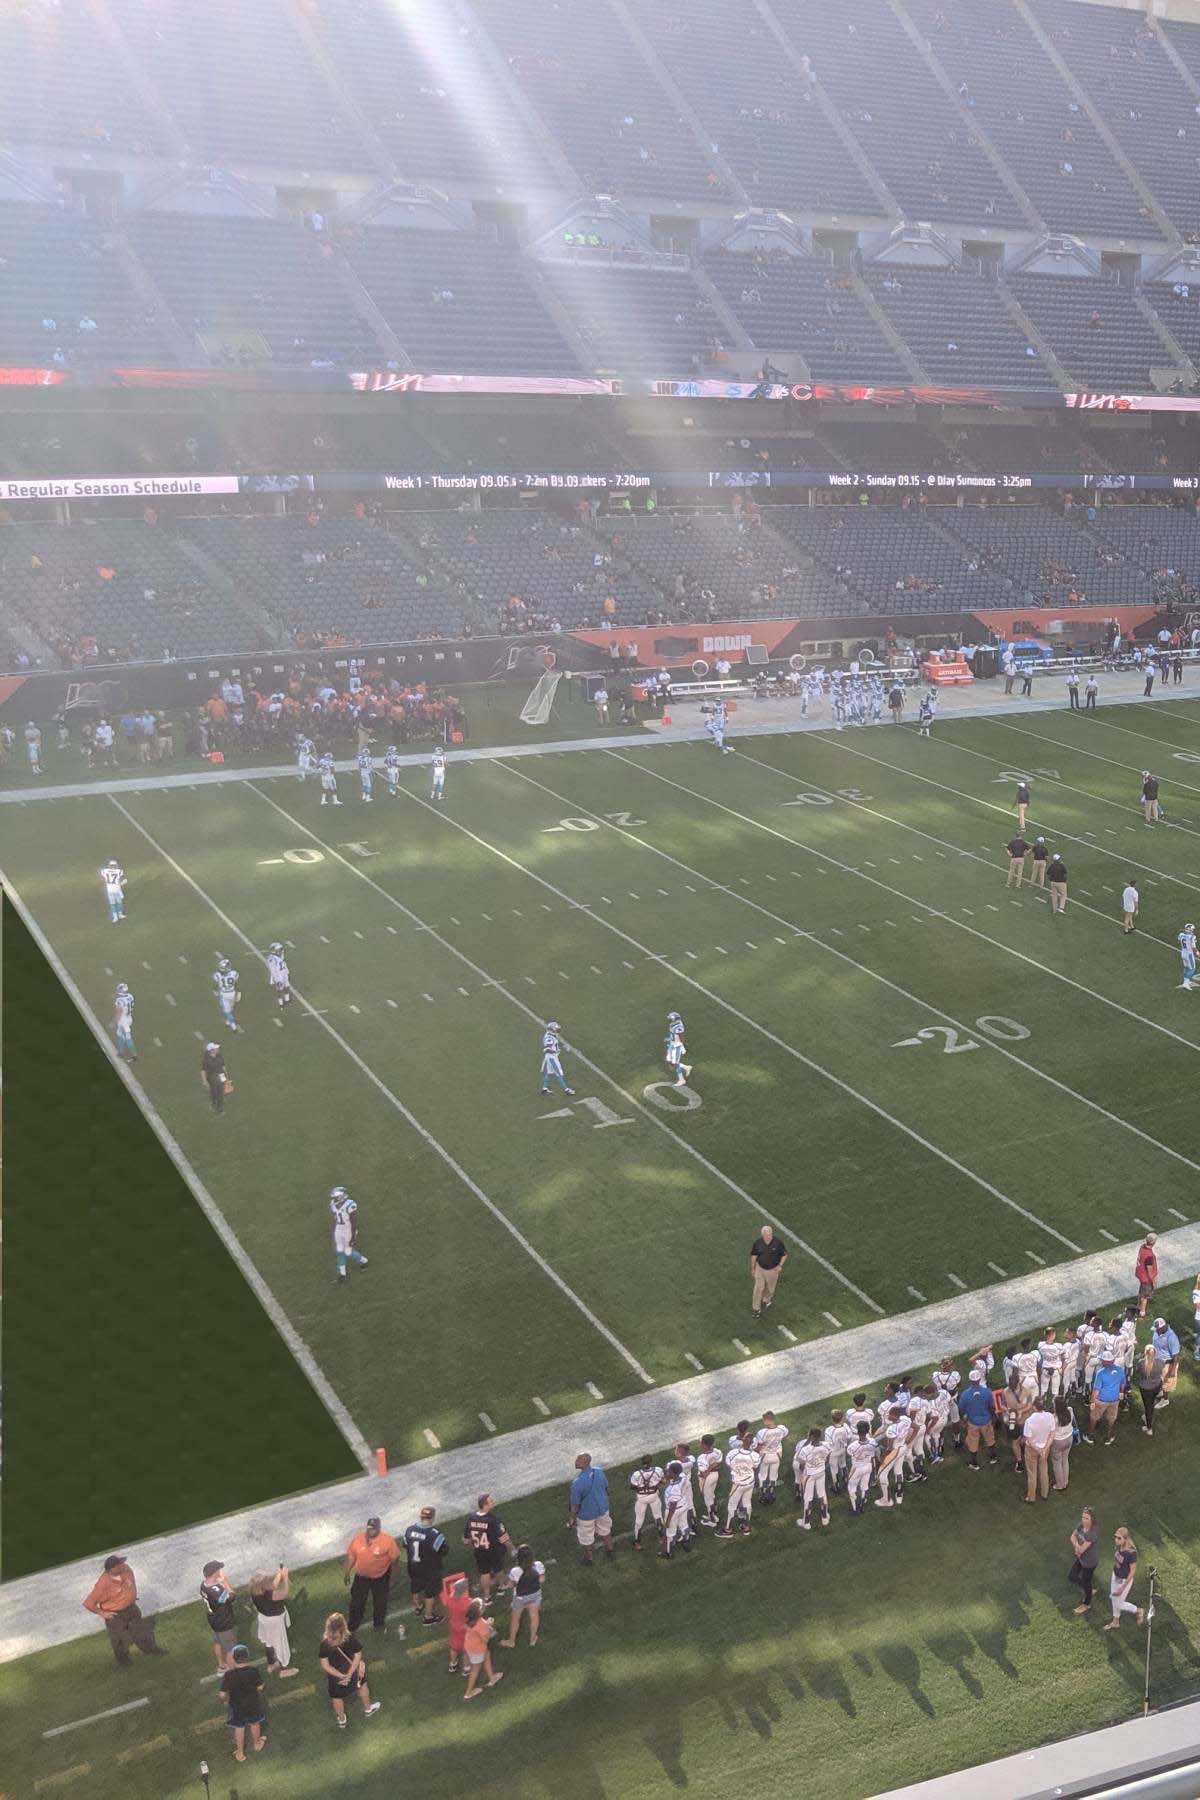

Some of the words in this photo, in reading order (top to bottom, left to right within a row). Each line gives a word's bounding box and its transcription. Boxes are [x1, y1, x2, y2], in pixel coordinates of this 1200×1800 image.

[8, 483, 69, 498] Regular
[74, 482, 129, 495] Season
[134, 480, 202, 493] Schedule
[385, 476, 414, 489] Week
[416, 476, 422, 488] 1
[431, 475, 478, 489] Thursday
[615, 475, 650, 487] 7:20pm
[829, 475, 852, 486] Week
[853, 475, 859, 486] 2
[867, 475, 896, 487] Sunday
[898, 475, 920, 486] 09.15
[1003, 475, 1032, 488] 3:25pm
[1173, 478, 1192, 488] Week
[1193, 478, 1199, 488] 3
[556, 811, 648, 833] 20
[282, 840, 380, 865] 10
[916, 1015, 1031, 1055] 20
[573, 1081, 702, 1129] 10
[470, 1530, 490, 1549] 54
[413, 1541, 420, 1563] 1
